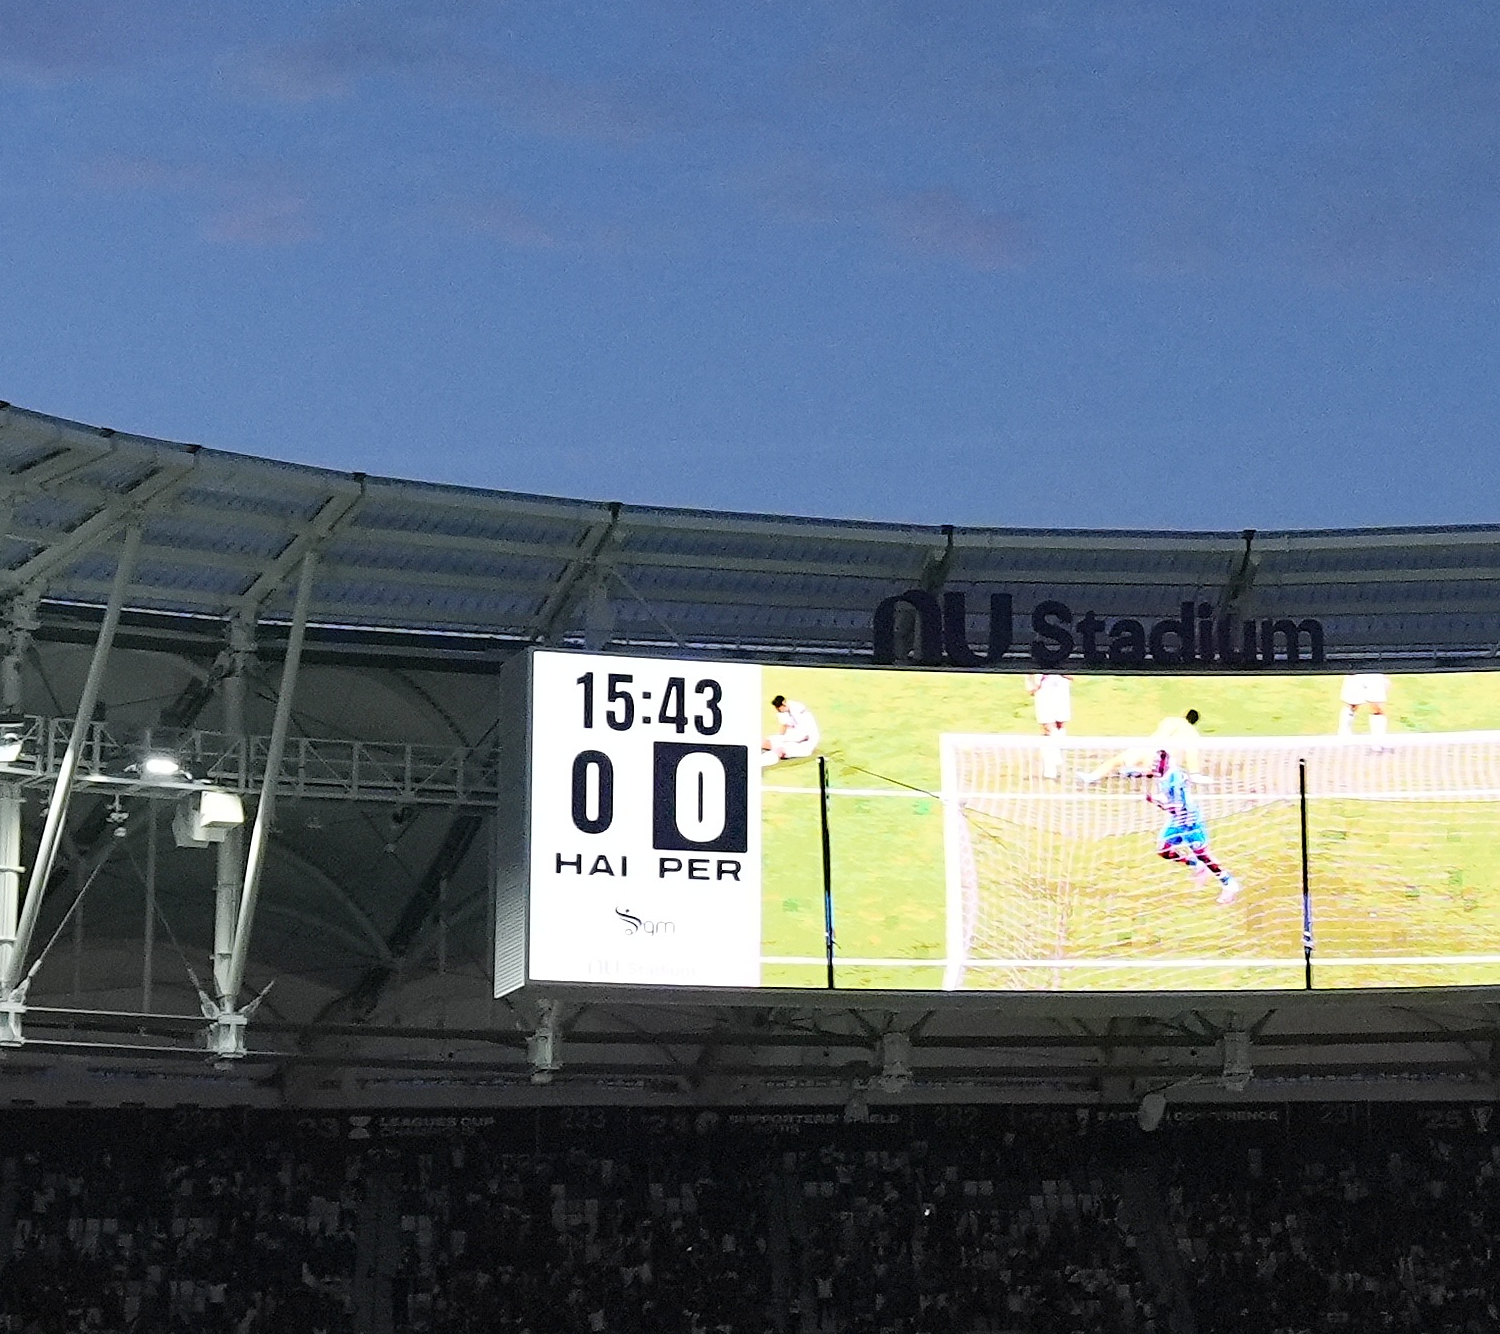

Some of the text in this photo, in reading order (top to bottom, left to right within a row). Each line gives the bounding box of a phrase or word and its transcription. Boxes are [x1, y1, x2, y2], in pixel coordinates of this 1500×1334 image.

[1030, 599, 1326, 668] Stadium
[576, 671, 723, 736] 15:43
[571, 749, 727, 844] 0 0
[555, 851, 743, 882] HAI PER
